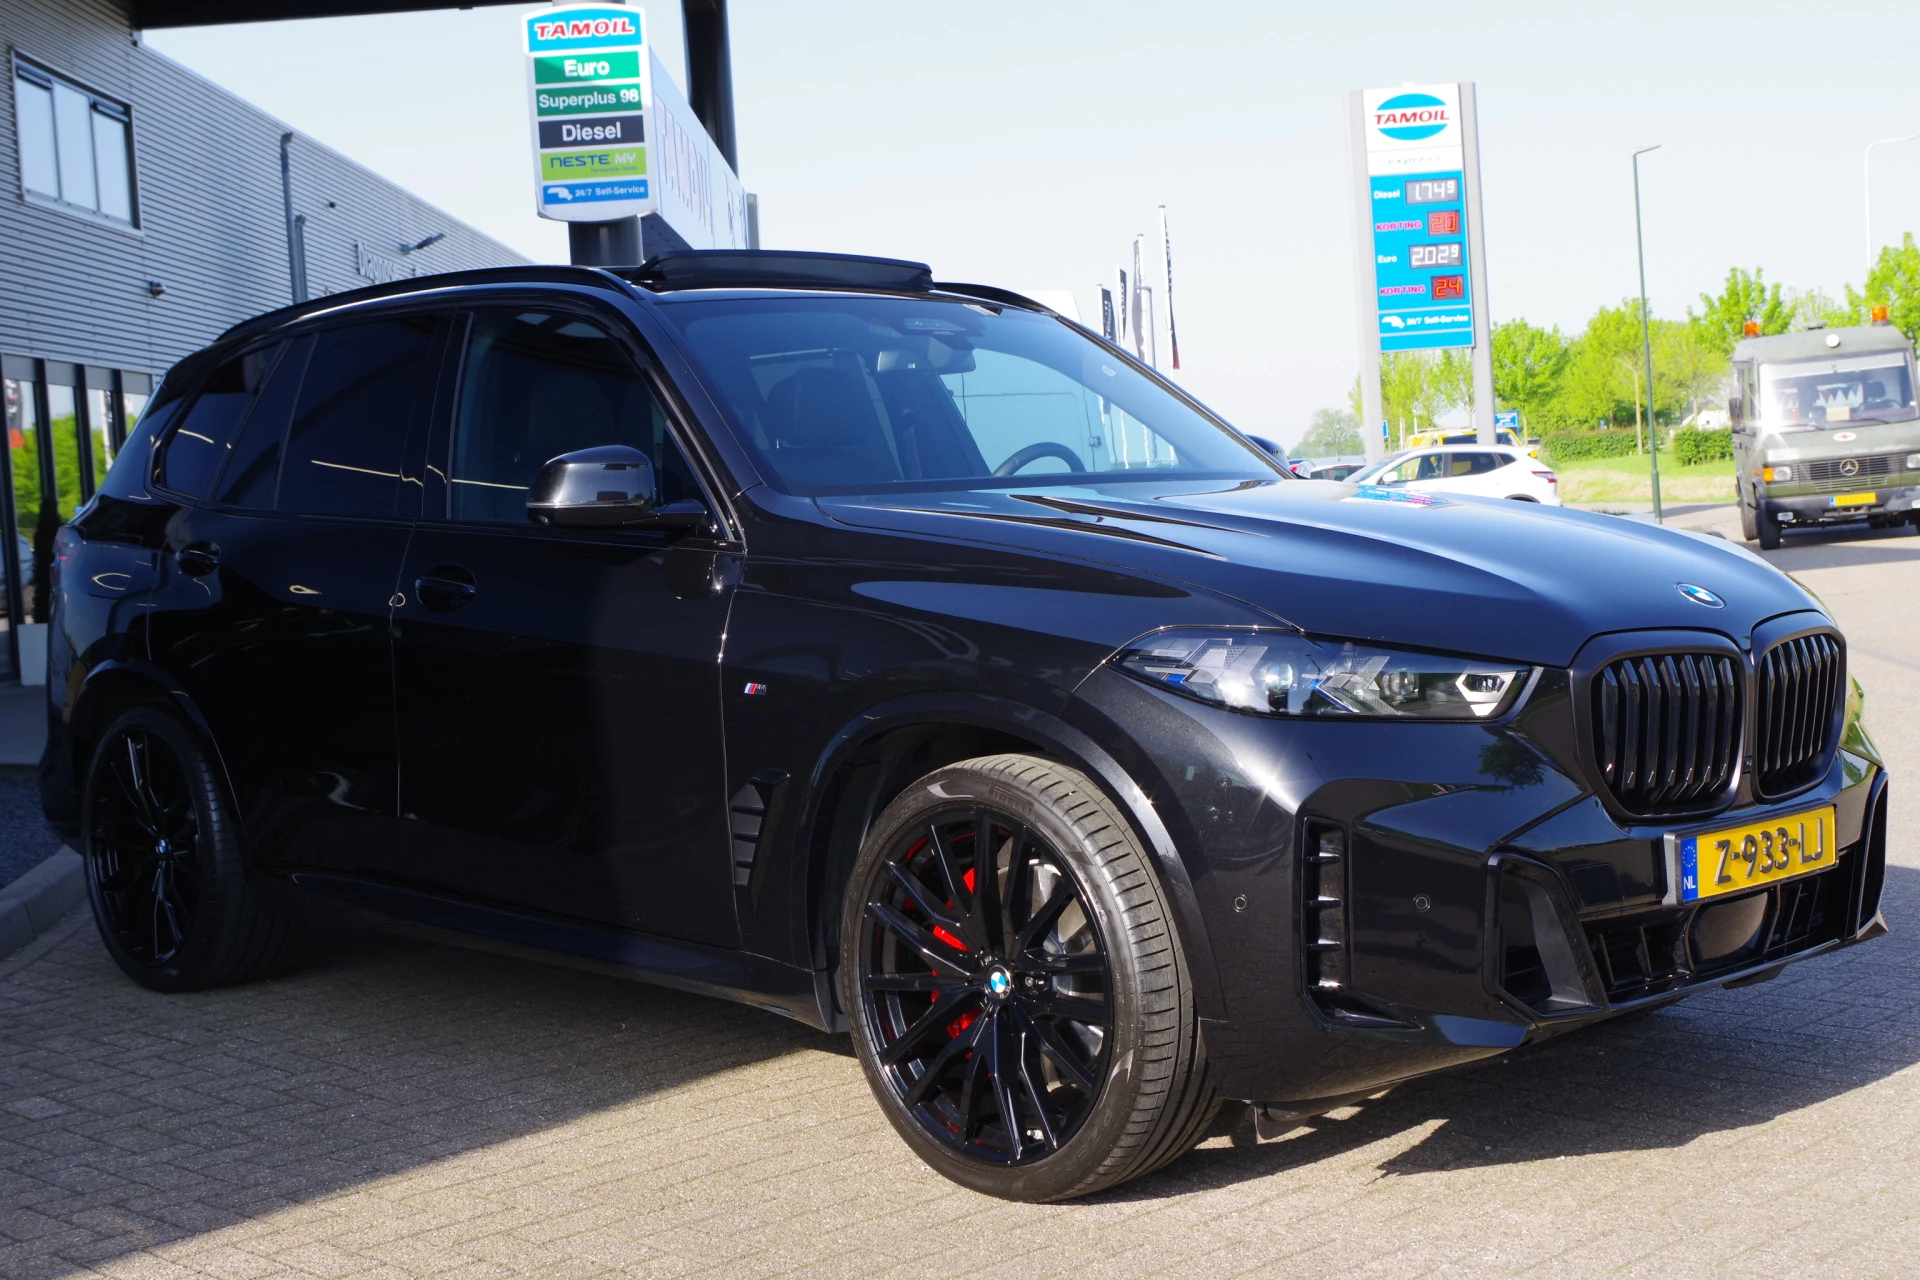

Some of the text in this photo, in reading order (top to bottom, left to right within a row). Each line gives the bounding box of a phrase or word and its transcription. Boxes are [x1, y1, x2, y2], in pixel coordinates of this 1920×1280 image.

[536, 19, 634, 38] TAMOIL
[564, 59, 610, 77] Euro
[539, 88, 640, 110] Superplus 98
[1374, 110, 1450, 125] TAMOIL
[562, 121, 621, 142] Diesel
[615, 152, 637, 164] MY
[575, 185, 645, 197] 24/7 Self-Service
[1374, 189, 1400, 199] Diesel
[1376, 220, 1422, 231] KORTING
[1377, 255, 1398, 264] Euro
[1380, 277, 1462, 297] KORTING 24
[1713, 818, 1824, 885] Z-933-LJ
[1683, 876, 1697, 891] NL
